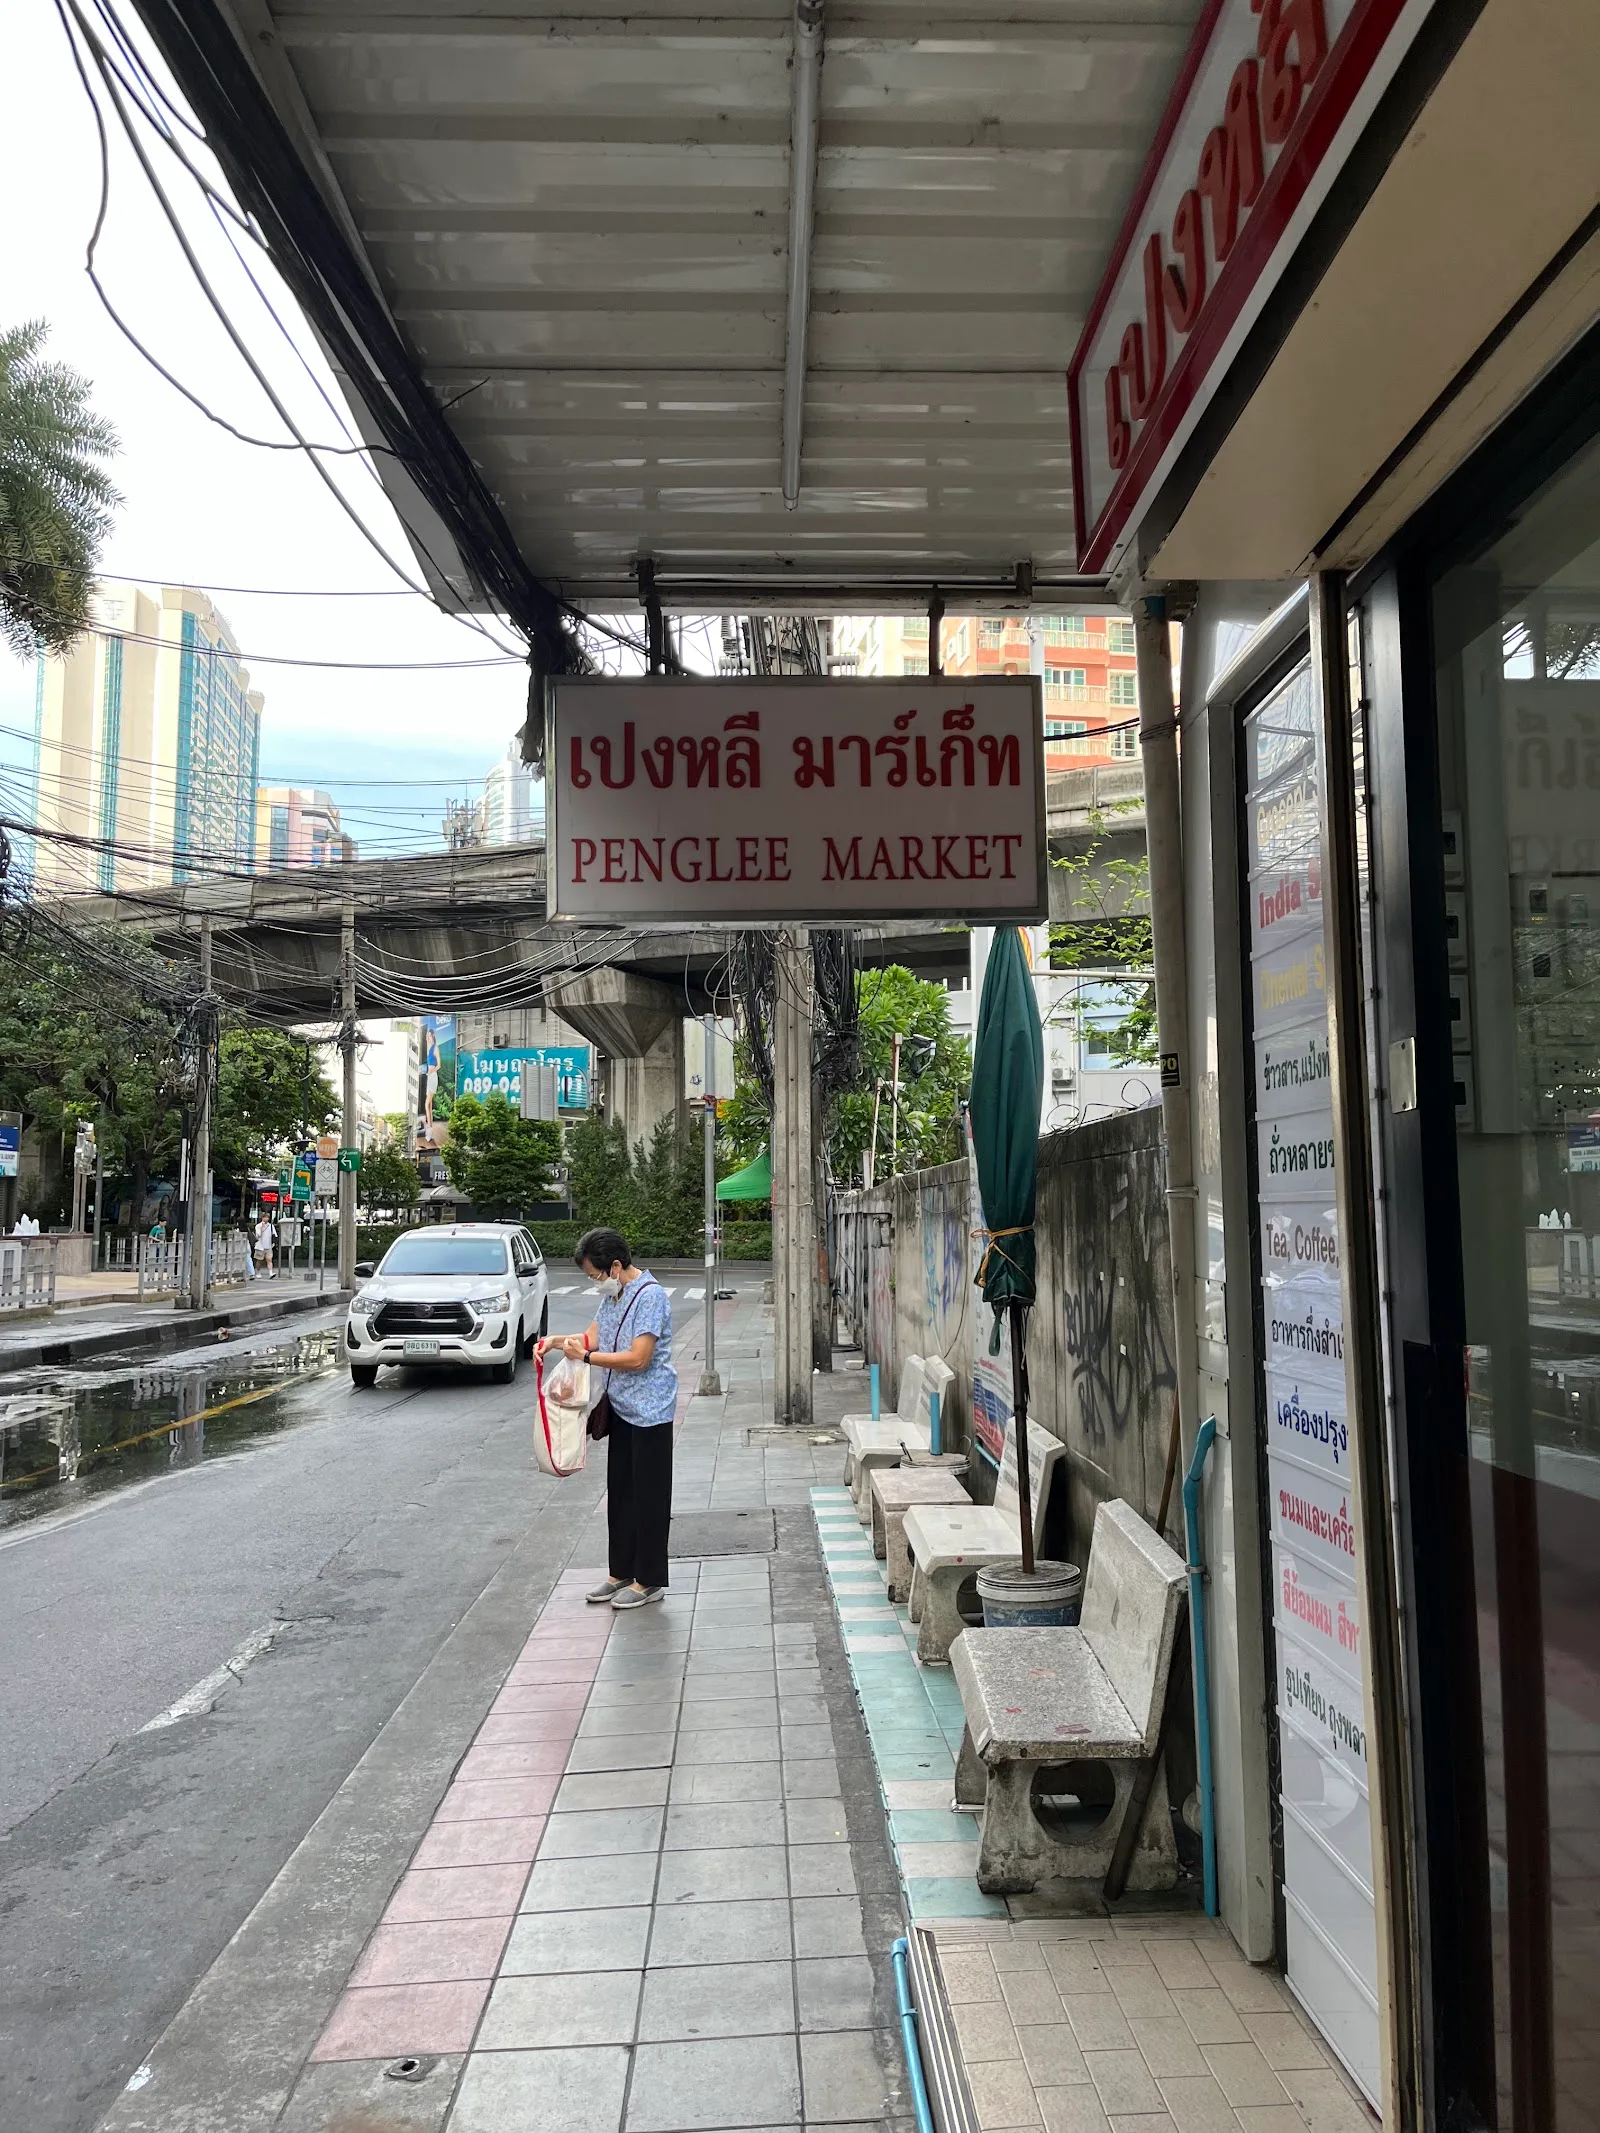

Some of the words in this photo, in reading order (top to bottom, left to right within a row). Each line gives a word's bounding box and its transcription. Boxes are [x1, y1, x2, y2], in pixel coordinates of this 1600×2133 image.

[570, 711, 761, 789] เปงหลี
[793, 704, 1021, 788] มาร์เก็ท
[571, 837, 792, 884] PENGLEE
[821, 834, 1023, 881] MARKET
[1259, 872, 1301, 929] India
[1266, 1223, 1291, 1263] Tea,
[1295, 1224, 1339, 1269] Coffee,
[1271, 1305, 1344, 1360] อาหารกึ่งสำเ
[1277, 1385, 1349, 1465] เครื่องปรุง
[1283, 1567, 1333, 1638] สีย้อมผม
[1337, 1600, 1360, 1654] สีท
